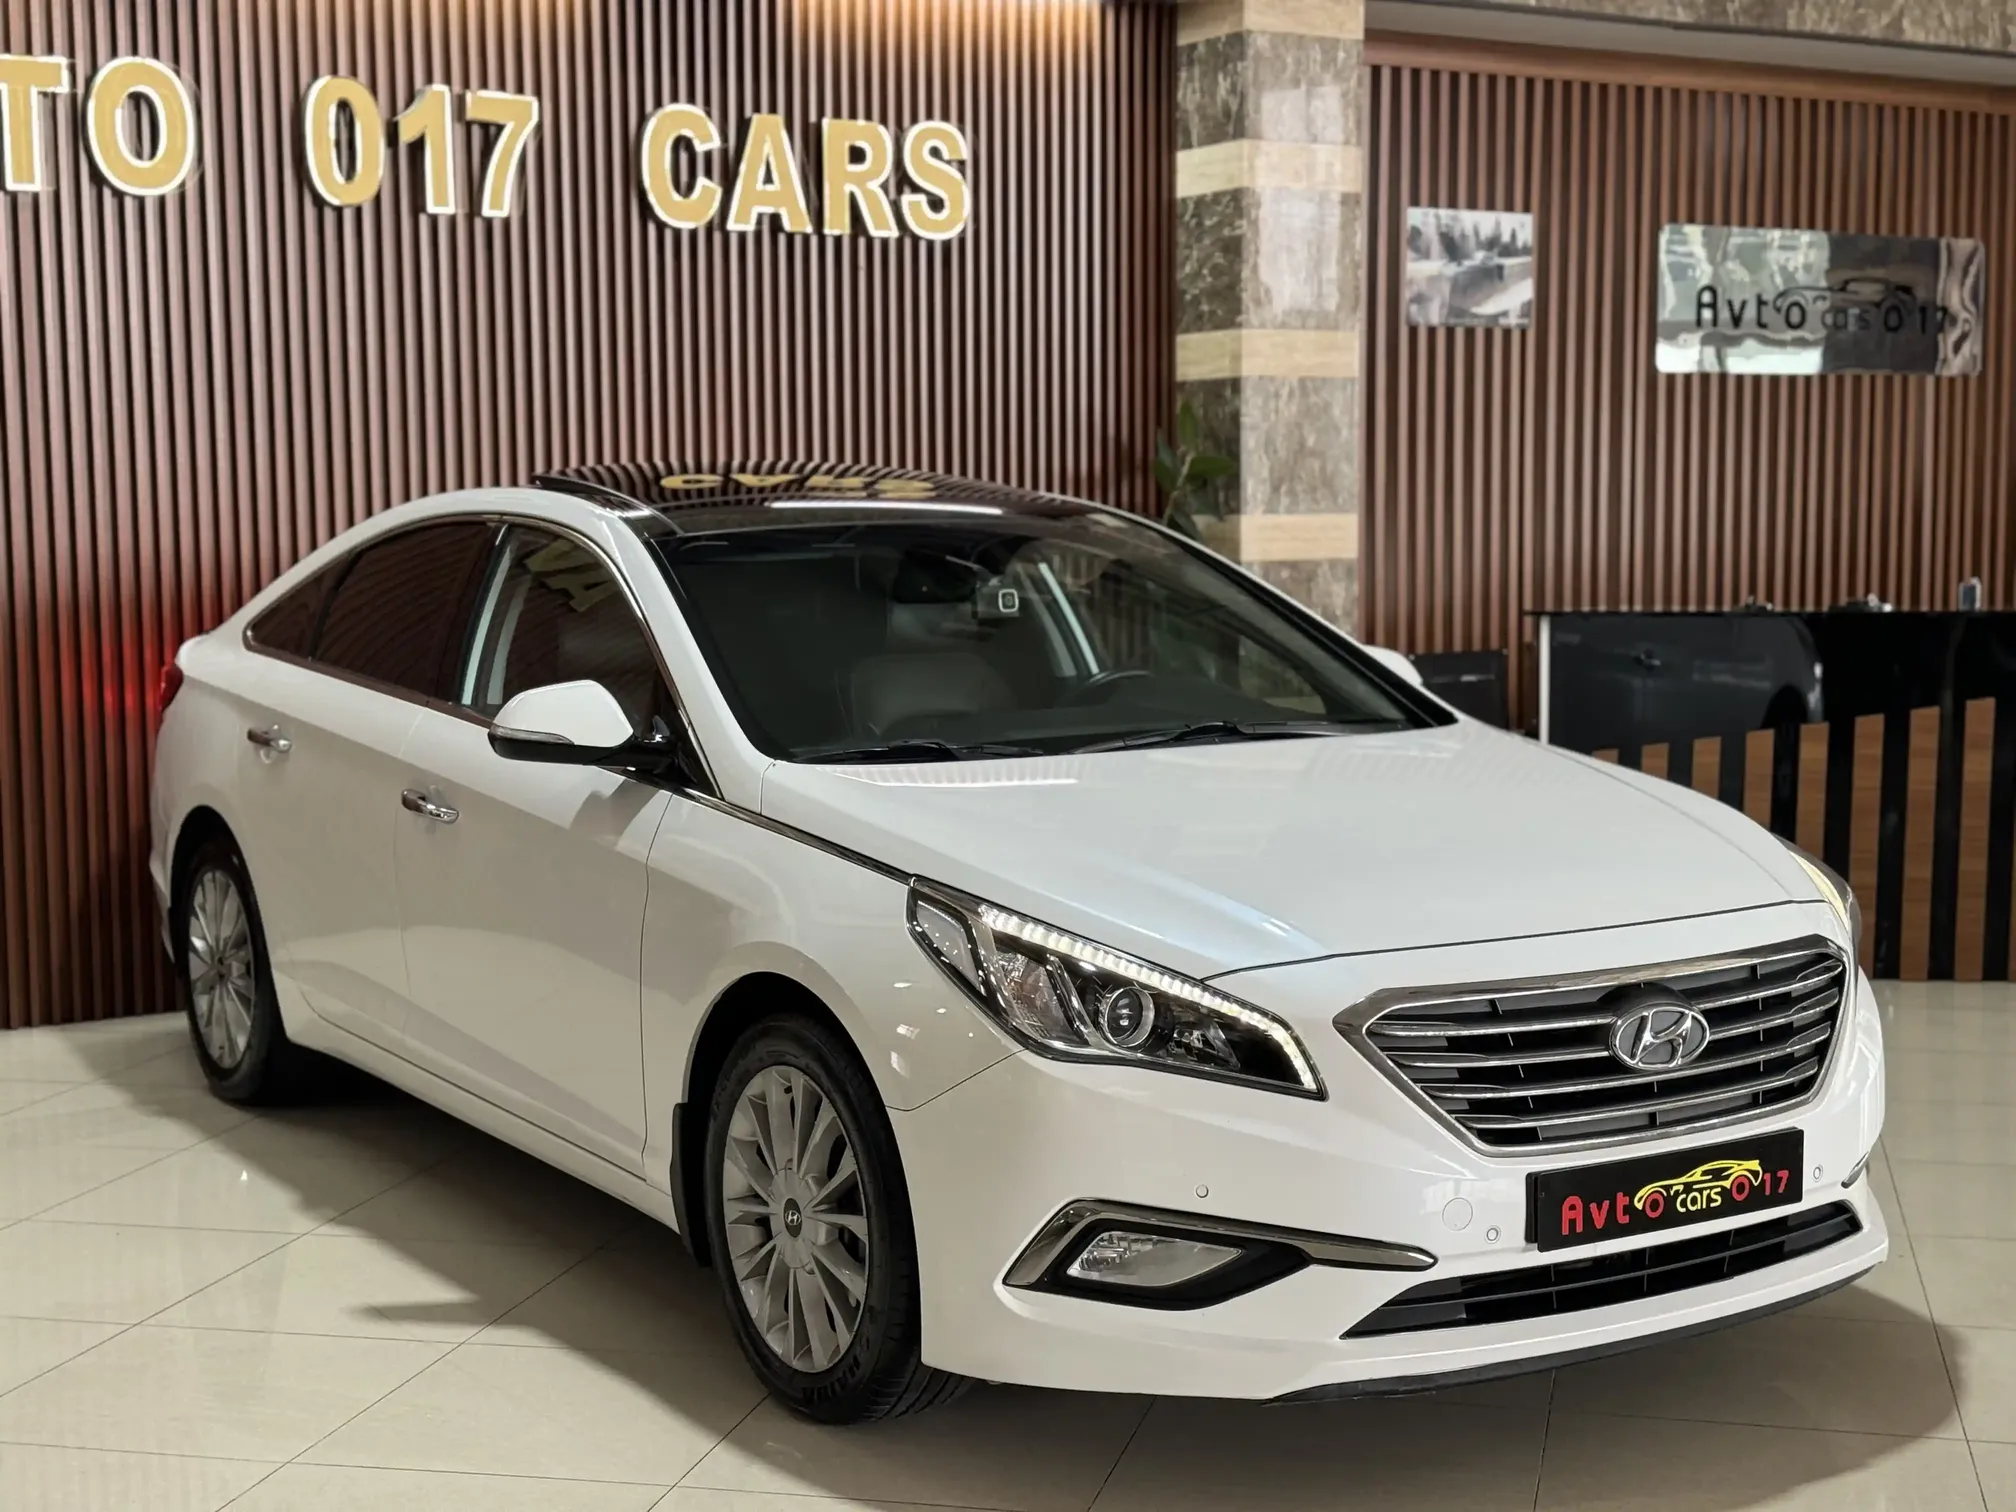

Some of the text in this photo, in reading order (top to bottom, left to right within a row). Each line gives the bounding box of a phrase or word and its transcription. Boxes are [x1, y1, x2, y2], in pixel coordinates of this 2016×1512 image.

[304, 75, 540, 218] 017
[641, 103, 970, 240] CARS
[1696, 285, 1807, 330] Avto
[1561, 1190, 1665, 1236] Avto
[1675, 1186, 1722, 1213] cars
